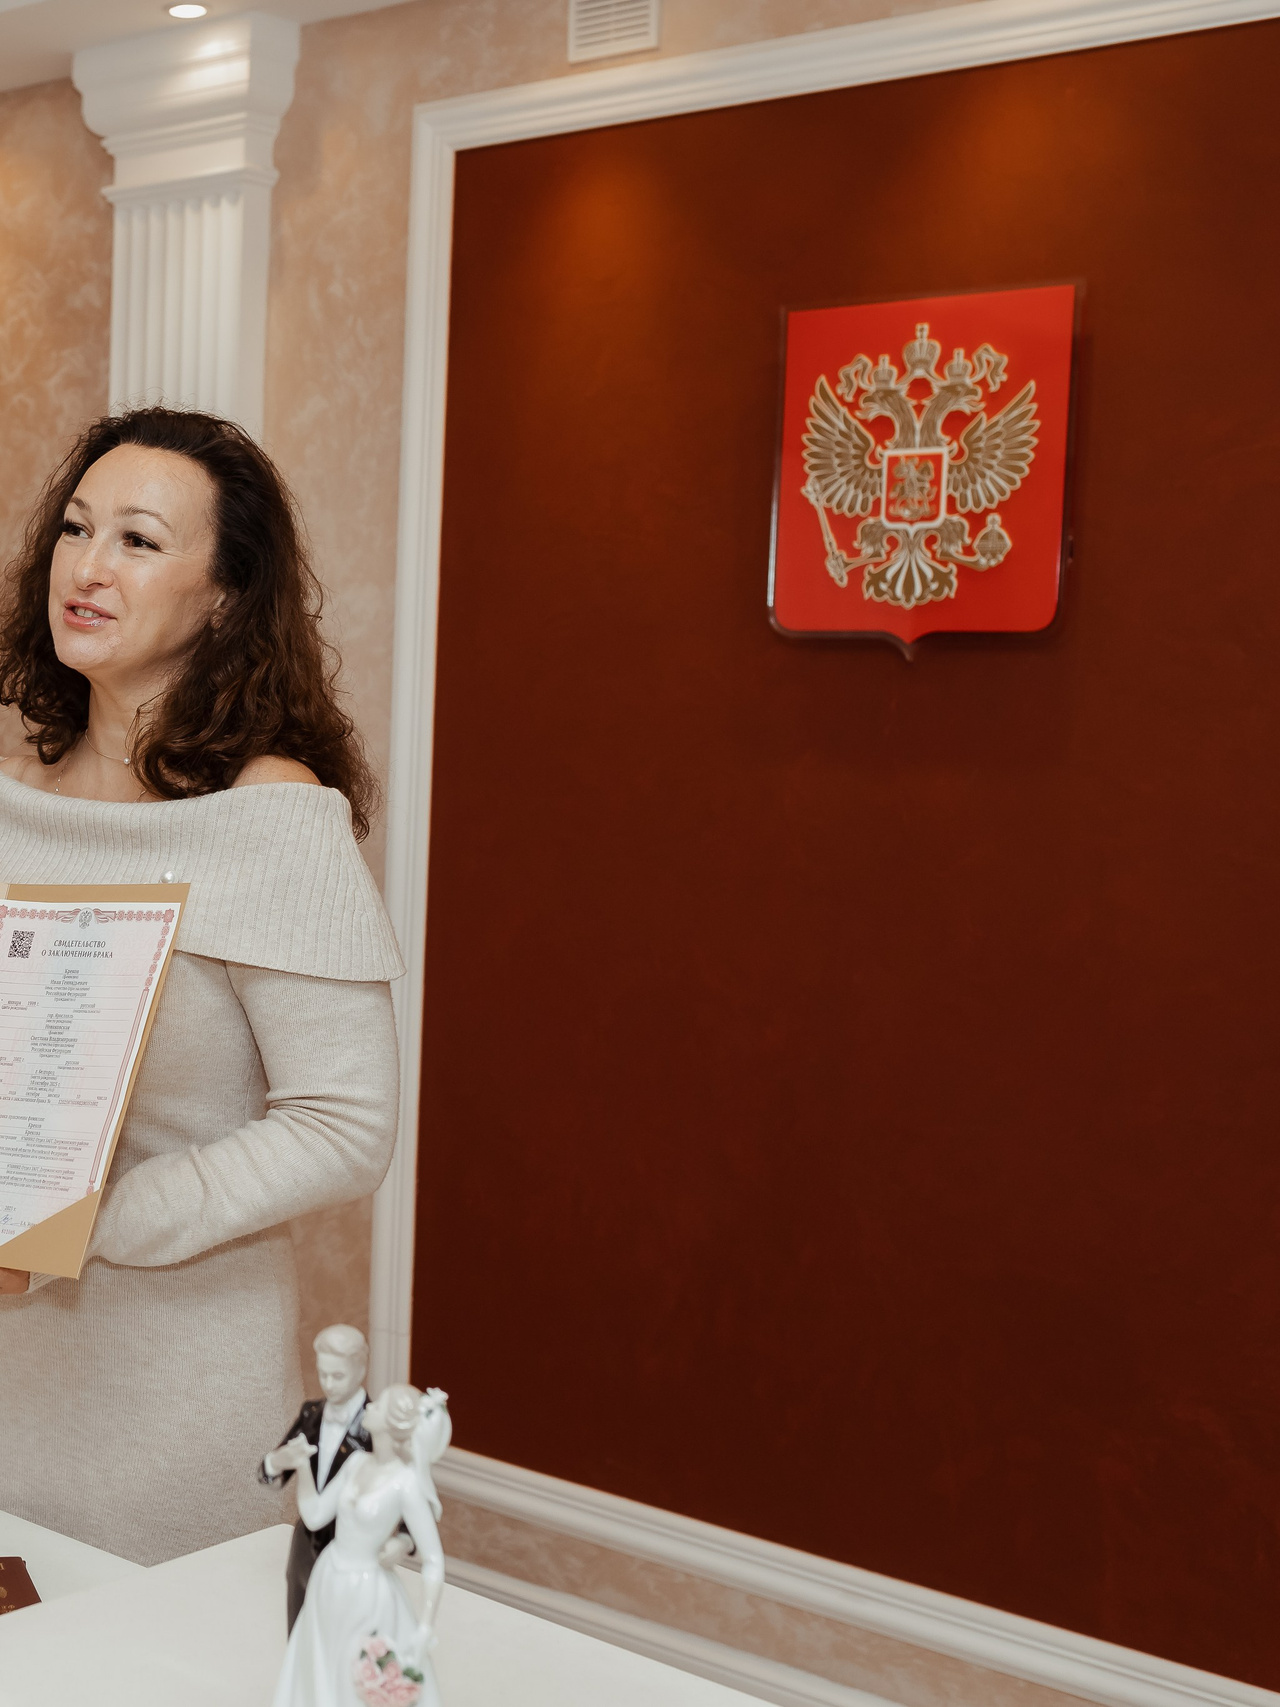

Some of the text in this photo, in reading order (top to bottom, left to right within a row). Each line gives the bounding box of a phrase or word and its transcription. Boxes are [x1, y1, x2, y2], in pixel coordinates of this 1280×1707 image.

[53, 939, 106, 948] СВИДЕТЕЛЬСТВО
[41, 949, 113, 959] О ЗАКЛЮЧЕНИИ БРАКА
